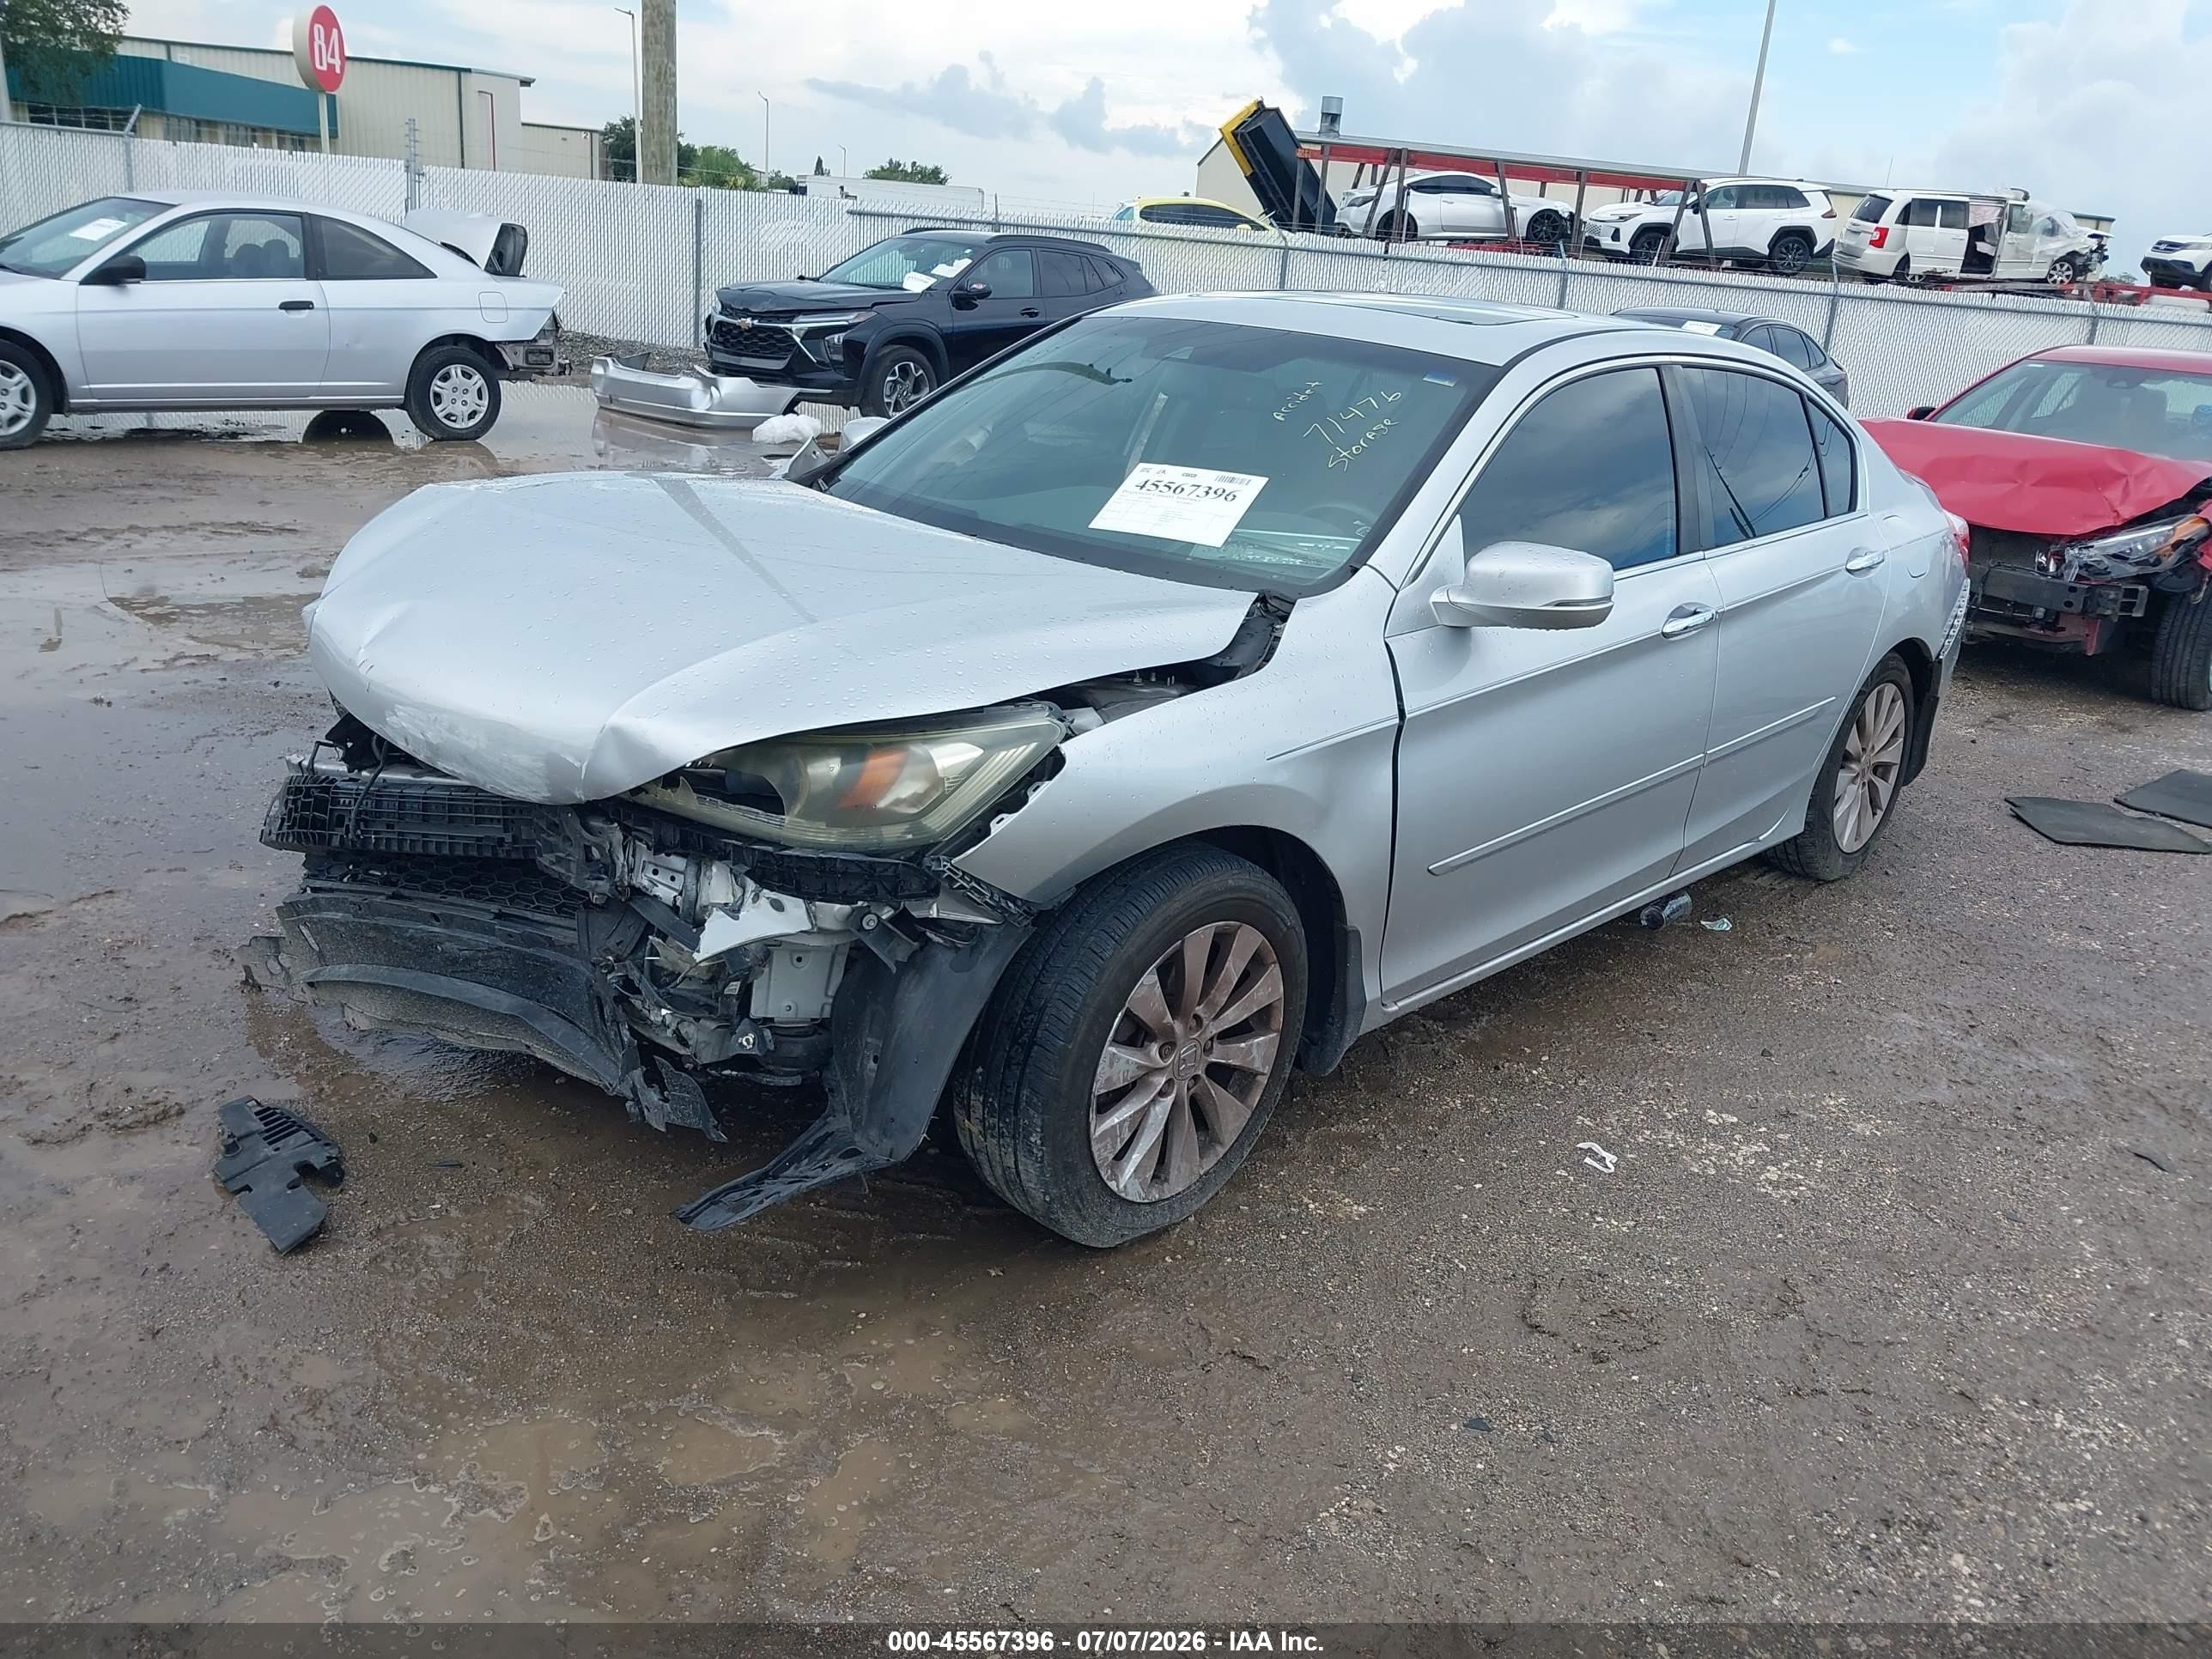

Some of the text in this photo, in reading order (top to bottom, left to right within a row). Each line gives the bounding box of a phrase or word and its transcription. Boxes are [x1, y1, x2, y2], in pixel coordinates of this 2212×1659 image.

[313, 23, 341, 74] 84
[1303, 391, 1401, 445] 71476
[1134, 479, 1243, 502] 45567396
